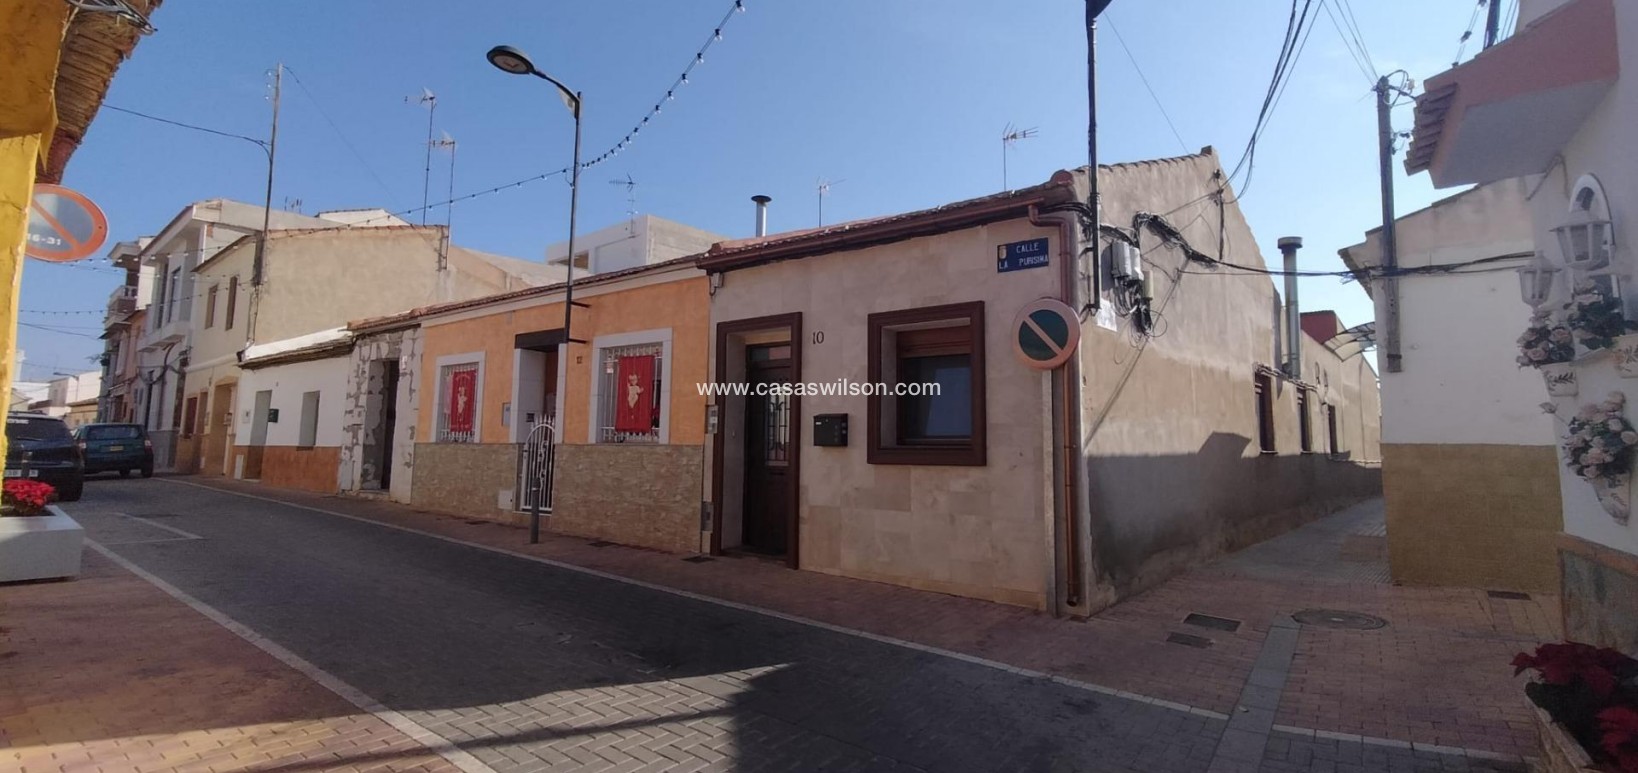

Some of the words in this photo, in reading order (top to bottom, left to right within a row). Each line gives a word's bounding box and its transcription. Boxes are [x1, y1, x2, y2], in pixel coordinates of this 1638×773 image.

[1016, 242, 1039, 253] CALLE
[999, 260, 1008, 270] LA
[813, 331, 824, 344] 10
